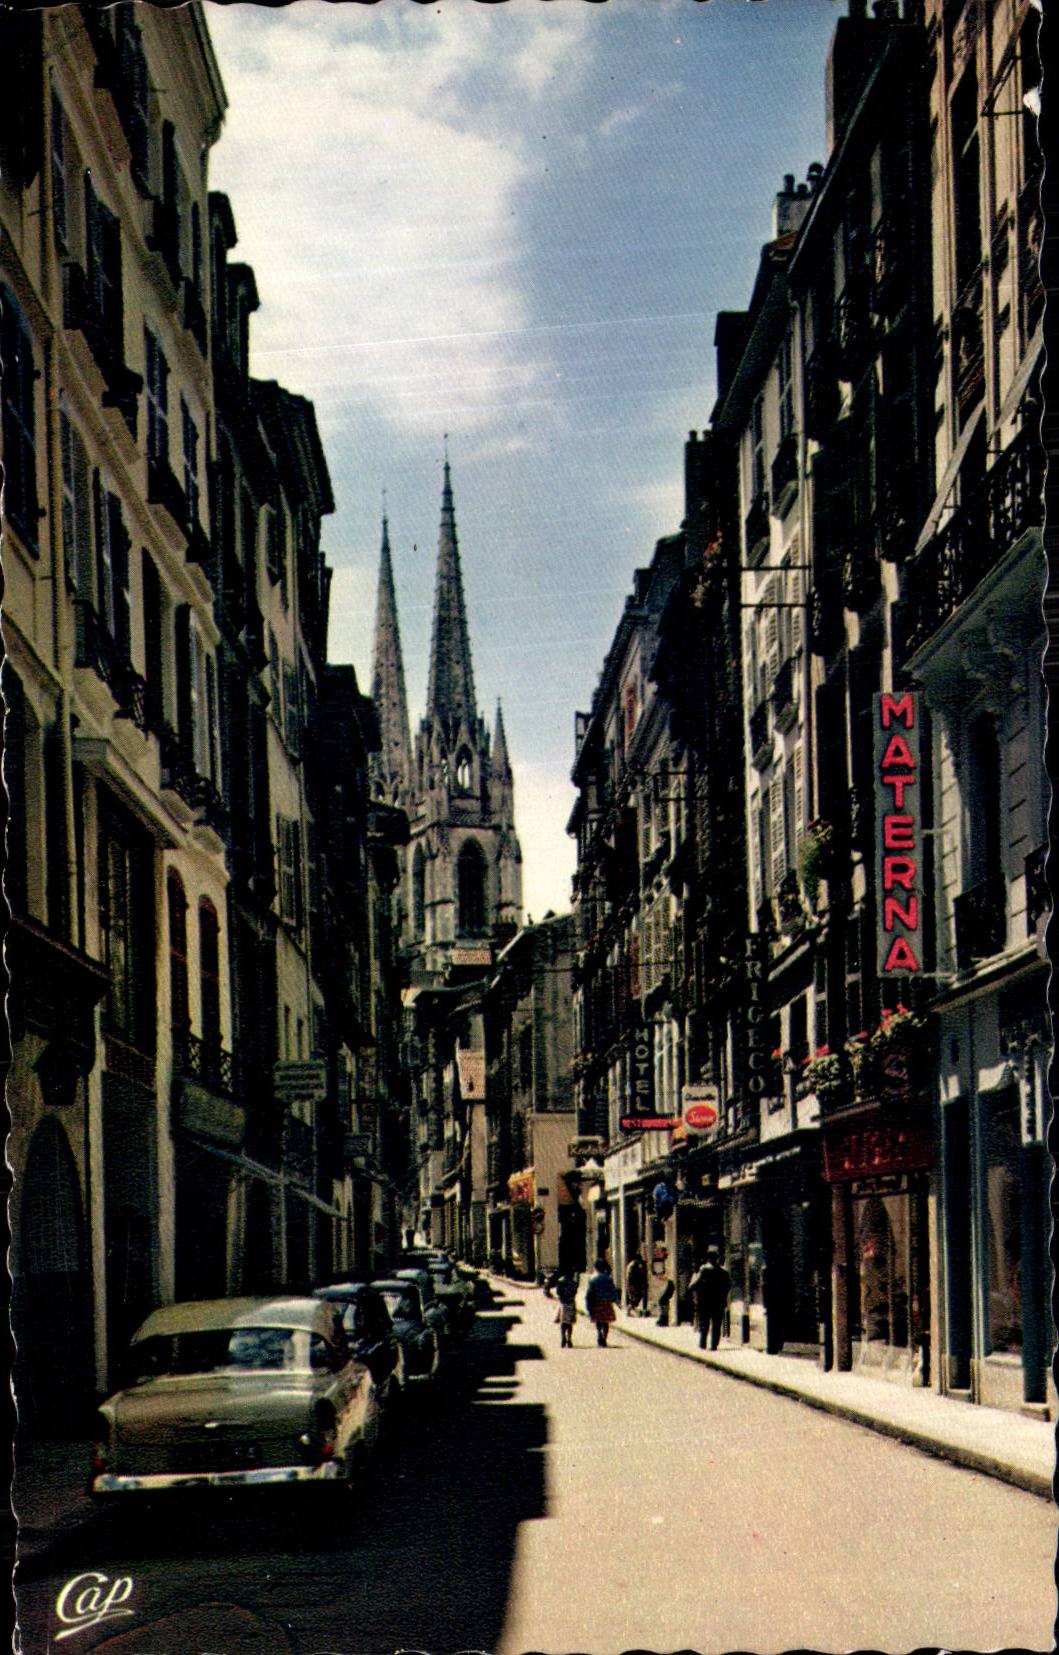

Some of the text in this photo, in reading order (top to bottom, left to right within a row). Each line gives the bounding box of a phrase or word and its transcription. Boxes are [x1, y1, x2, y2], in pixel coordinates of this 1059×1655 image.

[881, 693, 918, 972] MATERNA
[635, 1028, 650, 1111] HOTEL
[745, 938, 766, 1093] FRIGECO
